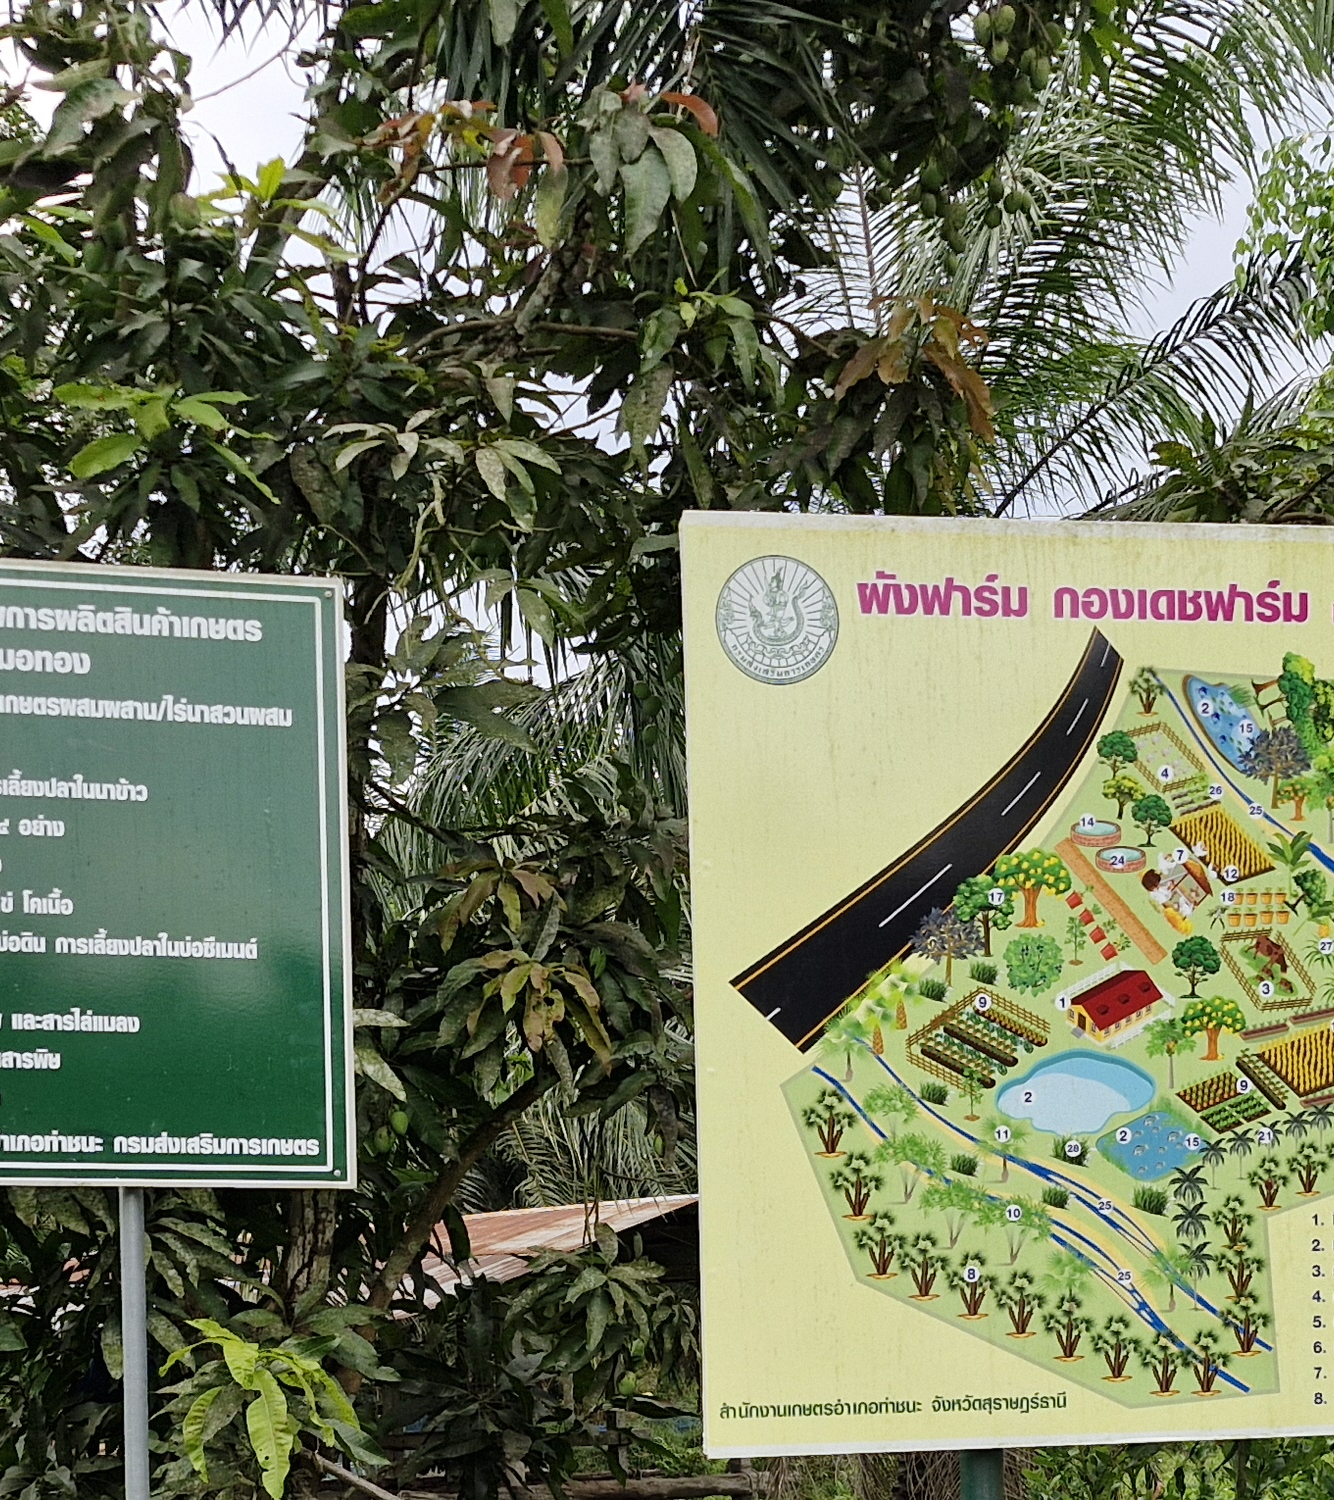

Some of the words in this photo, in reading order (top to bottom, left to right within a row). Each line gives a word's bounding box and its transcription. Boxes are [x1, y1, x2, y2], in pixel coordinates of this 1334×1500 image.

[856, 570, 1028, 618] ผังฟาร์ม
[1053, 579, 1308, 633] กองเดชฟาร์ม
[17, 813, 65, 837] อย่าง
[1080, 817, 1095, 828] 14
[1110, 855, 1125, 867] 24
[21, 887, 74, 916] โคเนื้อ
[989, 892, 1005, 902] 17
[54, 927, 258, 960] การเลี้ยงปลาในบ่อซีเมนต์
[978, 996, 987, 1008] 9
[10, 1006, 141, 1033] และสารไล่แมลง
[1023, 1091, 1033, 1104] 2
[113, 1130, 320, 1156] กรมส่งเสริมการเกษตร
[1311, 1213, 1324, 1226] 1.
[1310, 1238, 1325, 1252] 2.
[1311, 1264, 1325, 1278] 3.
[1311, 1289, 1326, 1303] 4.
[1312, 1314, 1326, 1328] 5.
[1312, 1340, 1327, 1354] 6.
[1313, 1366, 1327, 1380] 7.
[1313, 1391, 1328, 1405] 8.
[718, 1396, 923, 1419] สำนักงานเกษตรอำเภอท่าชนะ
